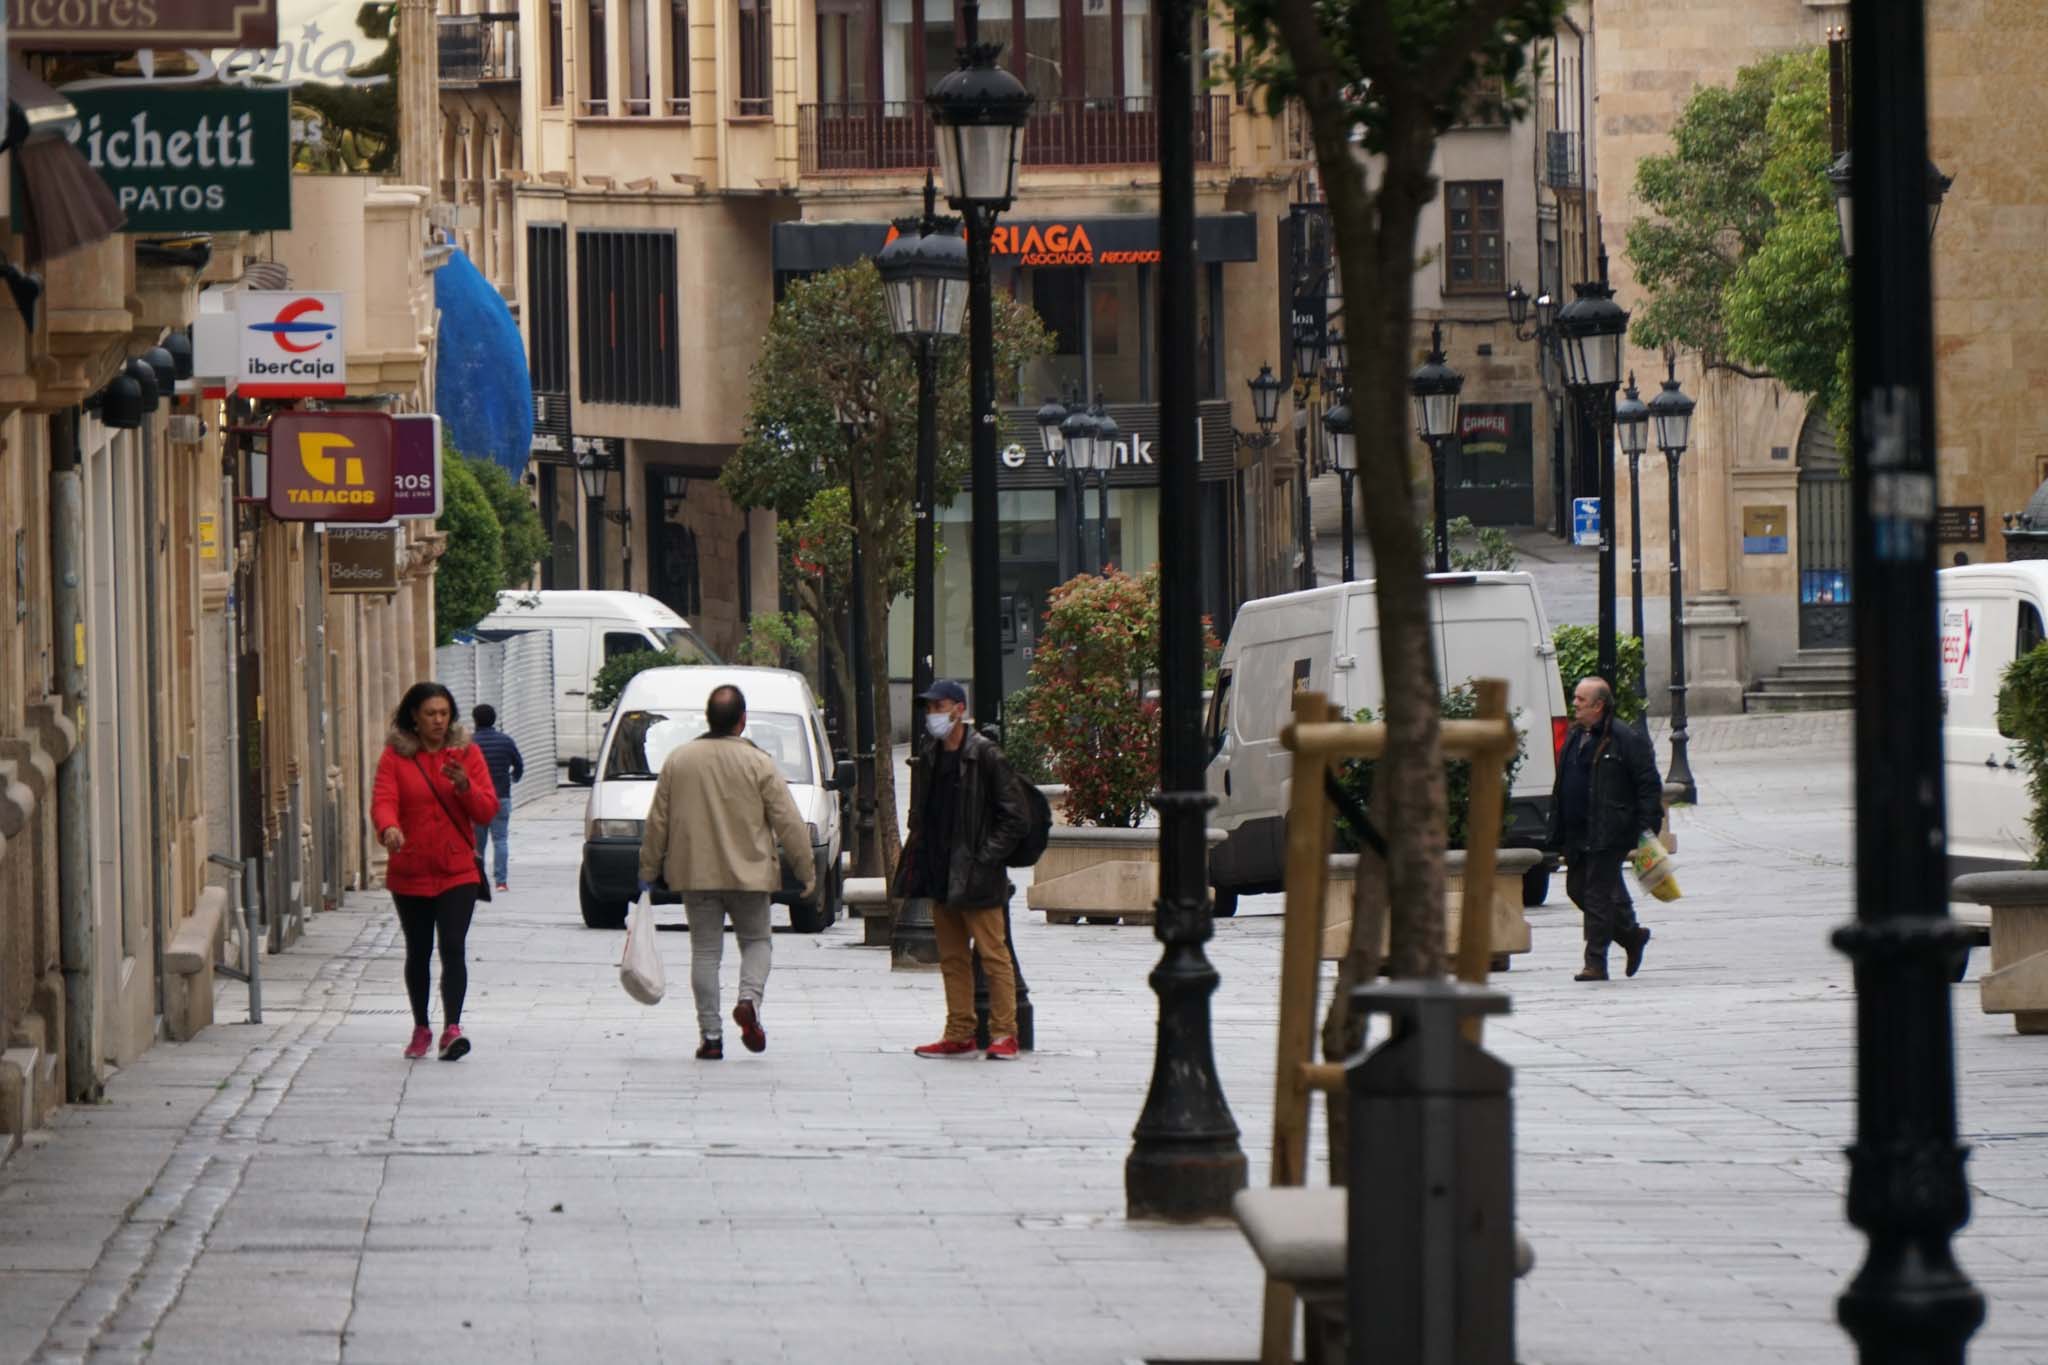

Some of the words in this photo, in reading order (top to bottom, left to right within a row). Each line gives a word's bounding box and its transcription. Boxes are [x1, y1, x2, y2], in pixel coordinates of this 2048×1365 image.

[12, 0, 158, 27] icores
[67, 111, 254, 168] ichetti
[120, 185, 224, 210] PATOS
[1020, 252, 1094, 265] ASOCIADOS
[248, 358, 335, 379] iberCaja
[1463, 416, 1505, 432] CAMPER
[394, 474, 431, 489] ROS
[287, 489, 376, 504] TABACOS
[329, 561, 384, 580] Bolsos
